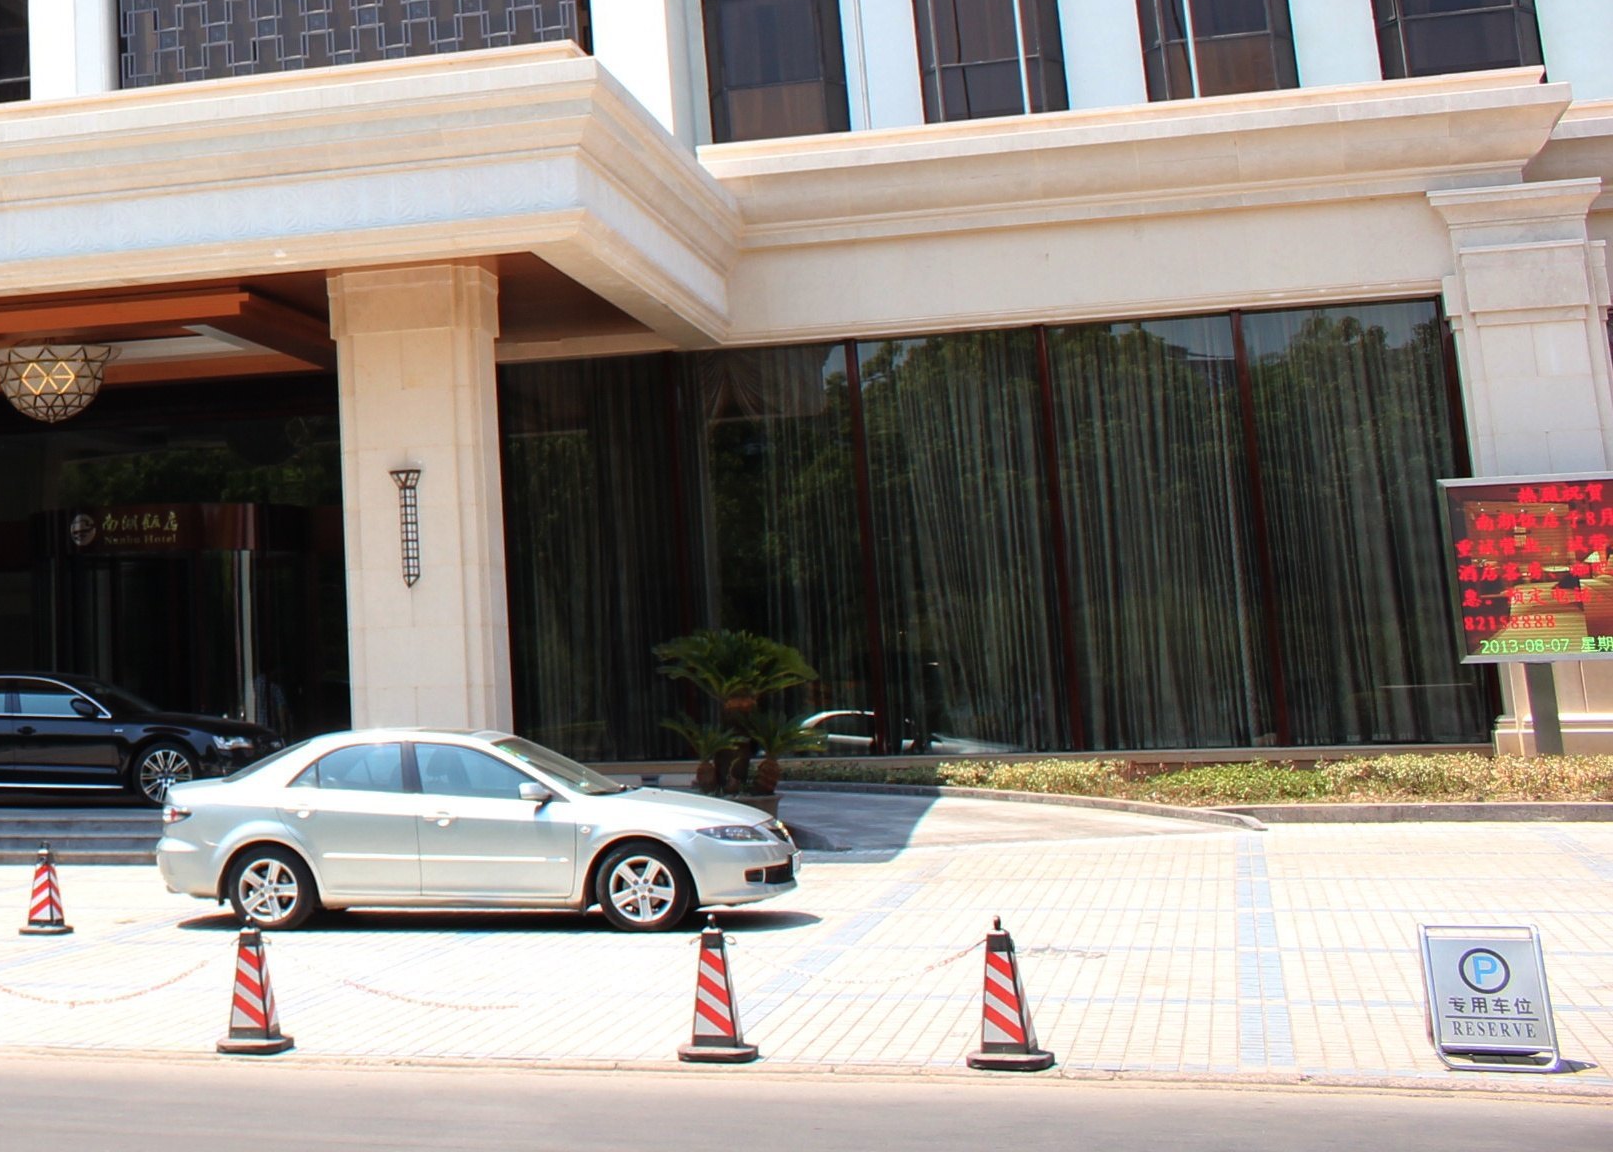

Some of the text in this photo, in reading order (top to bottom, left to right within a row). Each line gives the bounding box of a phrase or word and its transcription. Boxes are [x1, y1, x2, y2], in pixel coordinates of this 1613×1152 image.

[105, 533, 178, 545] Nanhu Hotel
[1464, 614, 1557, 632] 82158888
[1480, 637, 1570, 654] 2013-08-07
[1473, 956, 1497, 985] P
[1448, 996, 1534, 1015] 专用车位
[1453, 1021, 1536, 1038] RESERVE
